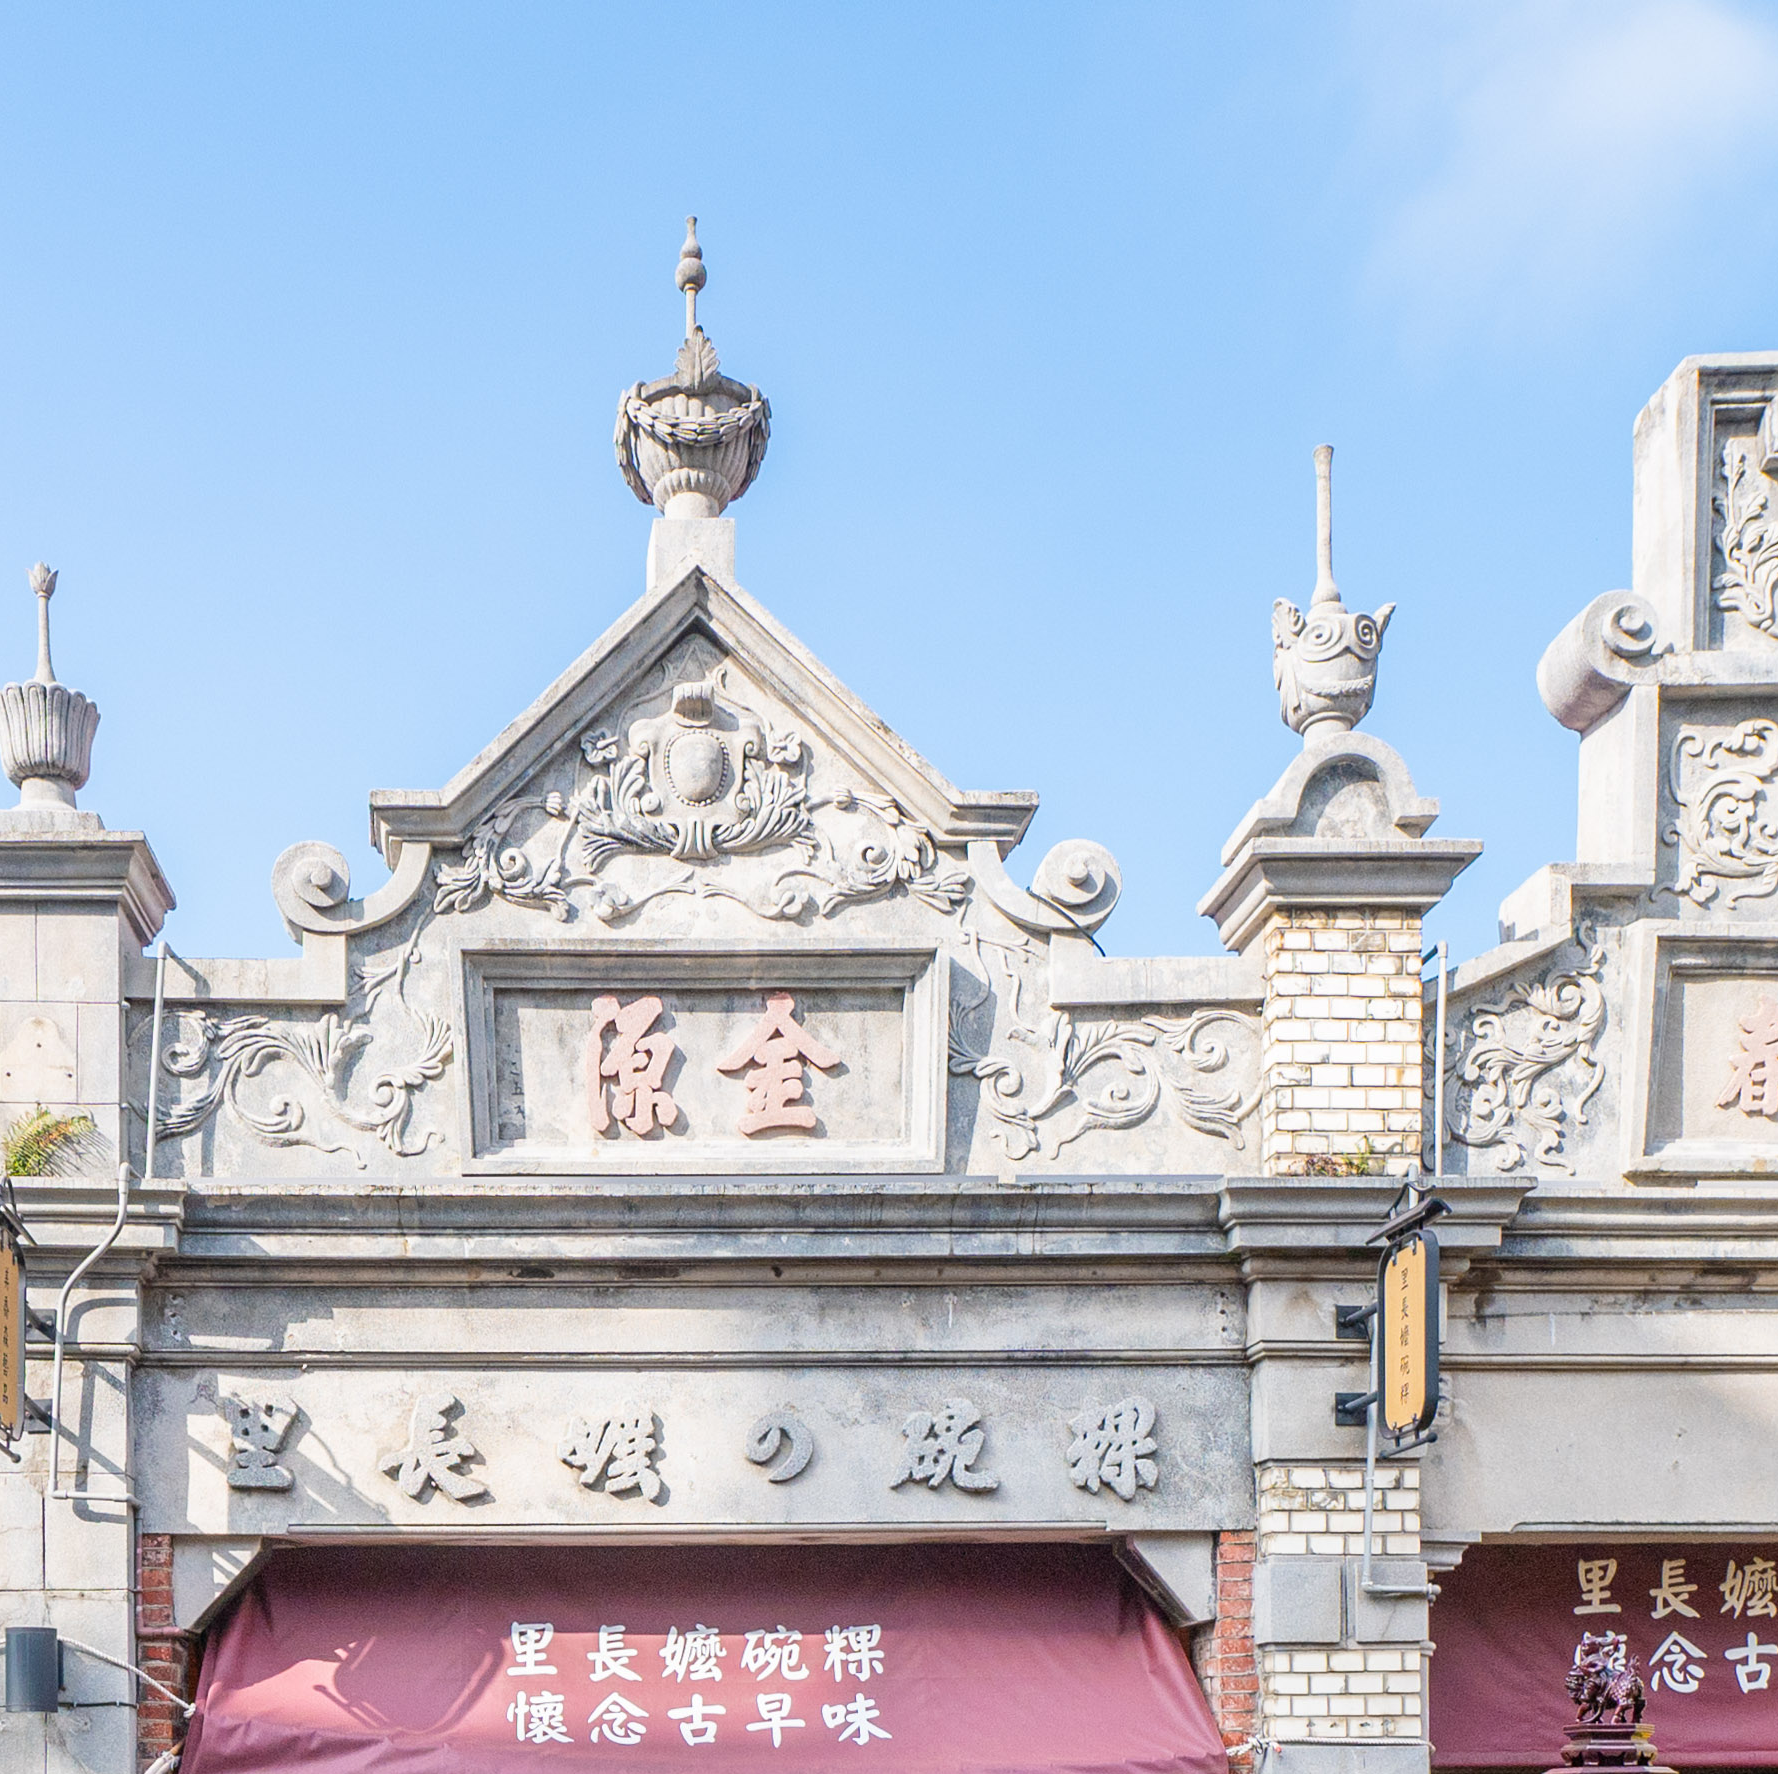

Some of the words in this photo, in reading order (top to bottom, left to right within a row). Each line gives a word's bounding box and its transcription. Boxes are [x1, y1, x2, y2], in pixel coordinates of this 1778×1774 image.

[506, 1621, 887, 1684] 里長嬤碗粿
[506, 1693, 894, 1747] 懷念古早味
